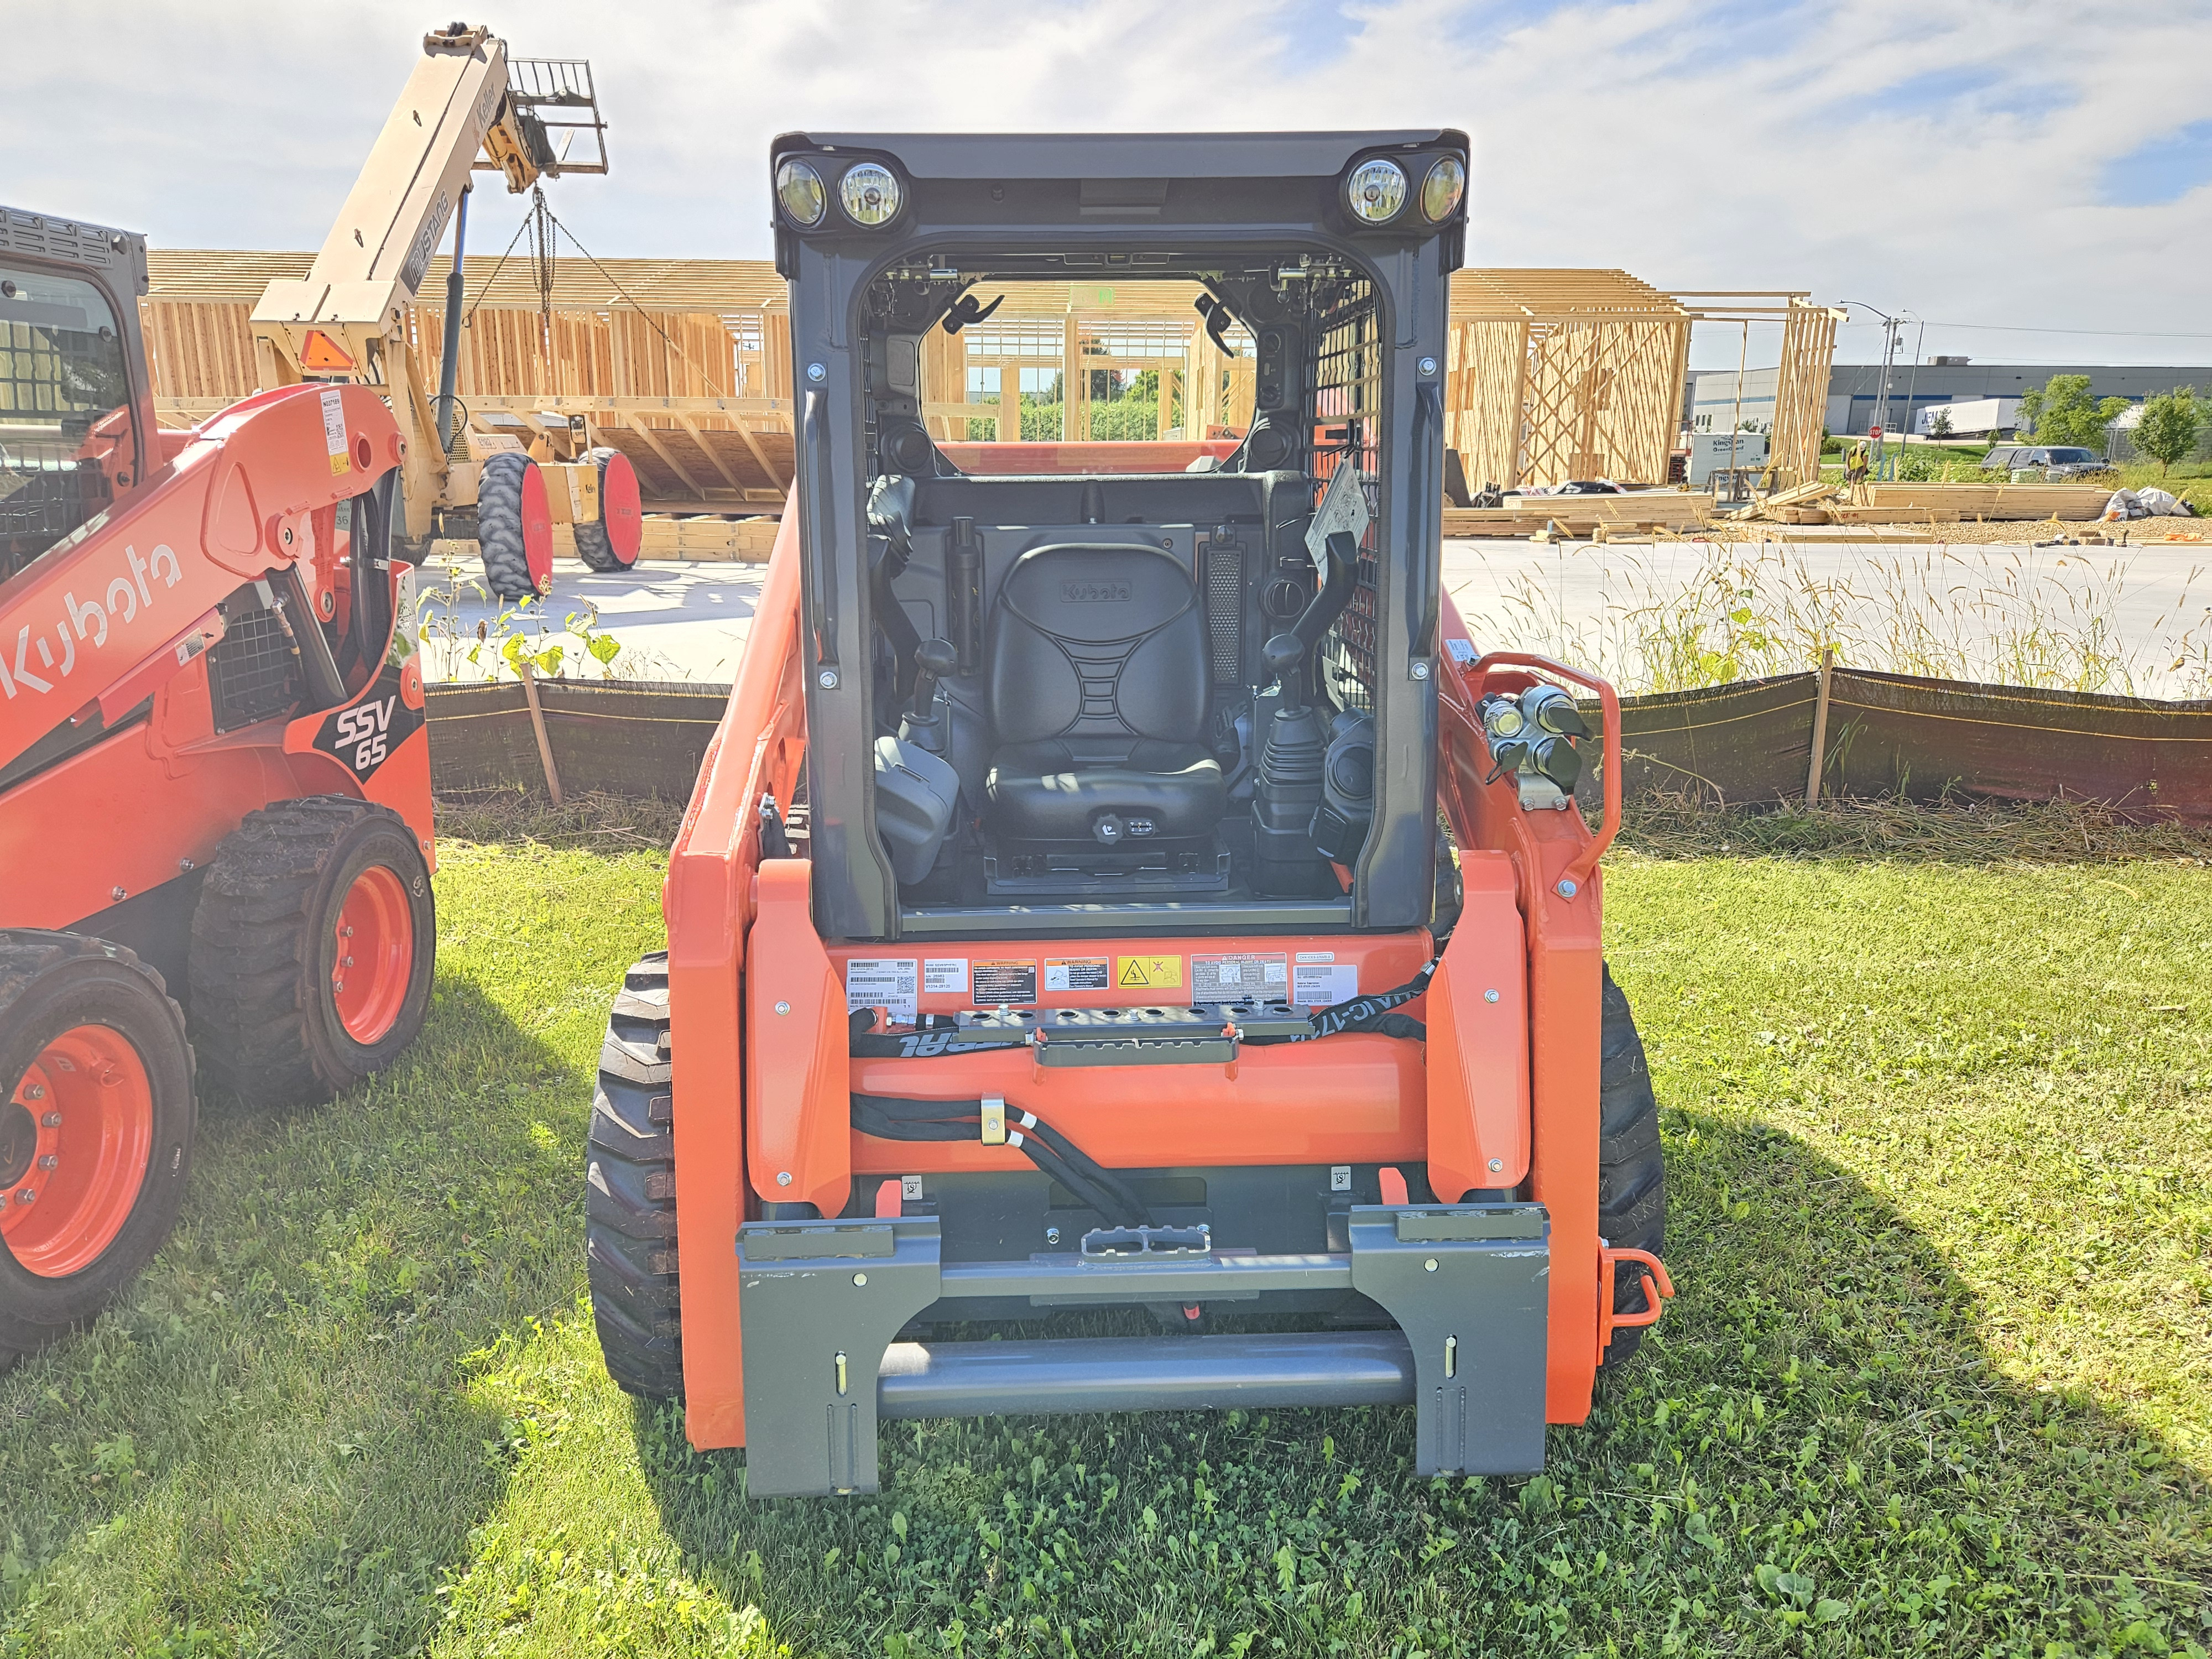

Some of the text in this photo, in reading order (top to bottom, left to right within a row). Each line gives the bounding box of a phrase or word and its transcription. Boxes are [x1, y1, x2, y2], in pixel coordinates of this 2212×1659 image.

[477, 82, 496, 129] Keller
[409, 189, 449, 285] MUSTANG
[1062, 583, 1129, 600] Kubota
[0, 544, 182, 700] Kubota
[335, 695, 396, 749] SSV
[356, 733, 387, 770] 65
